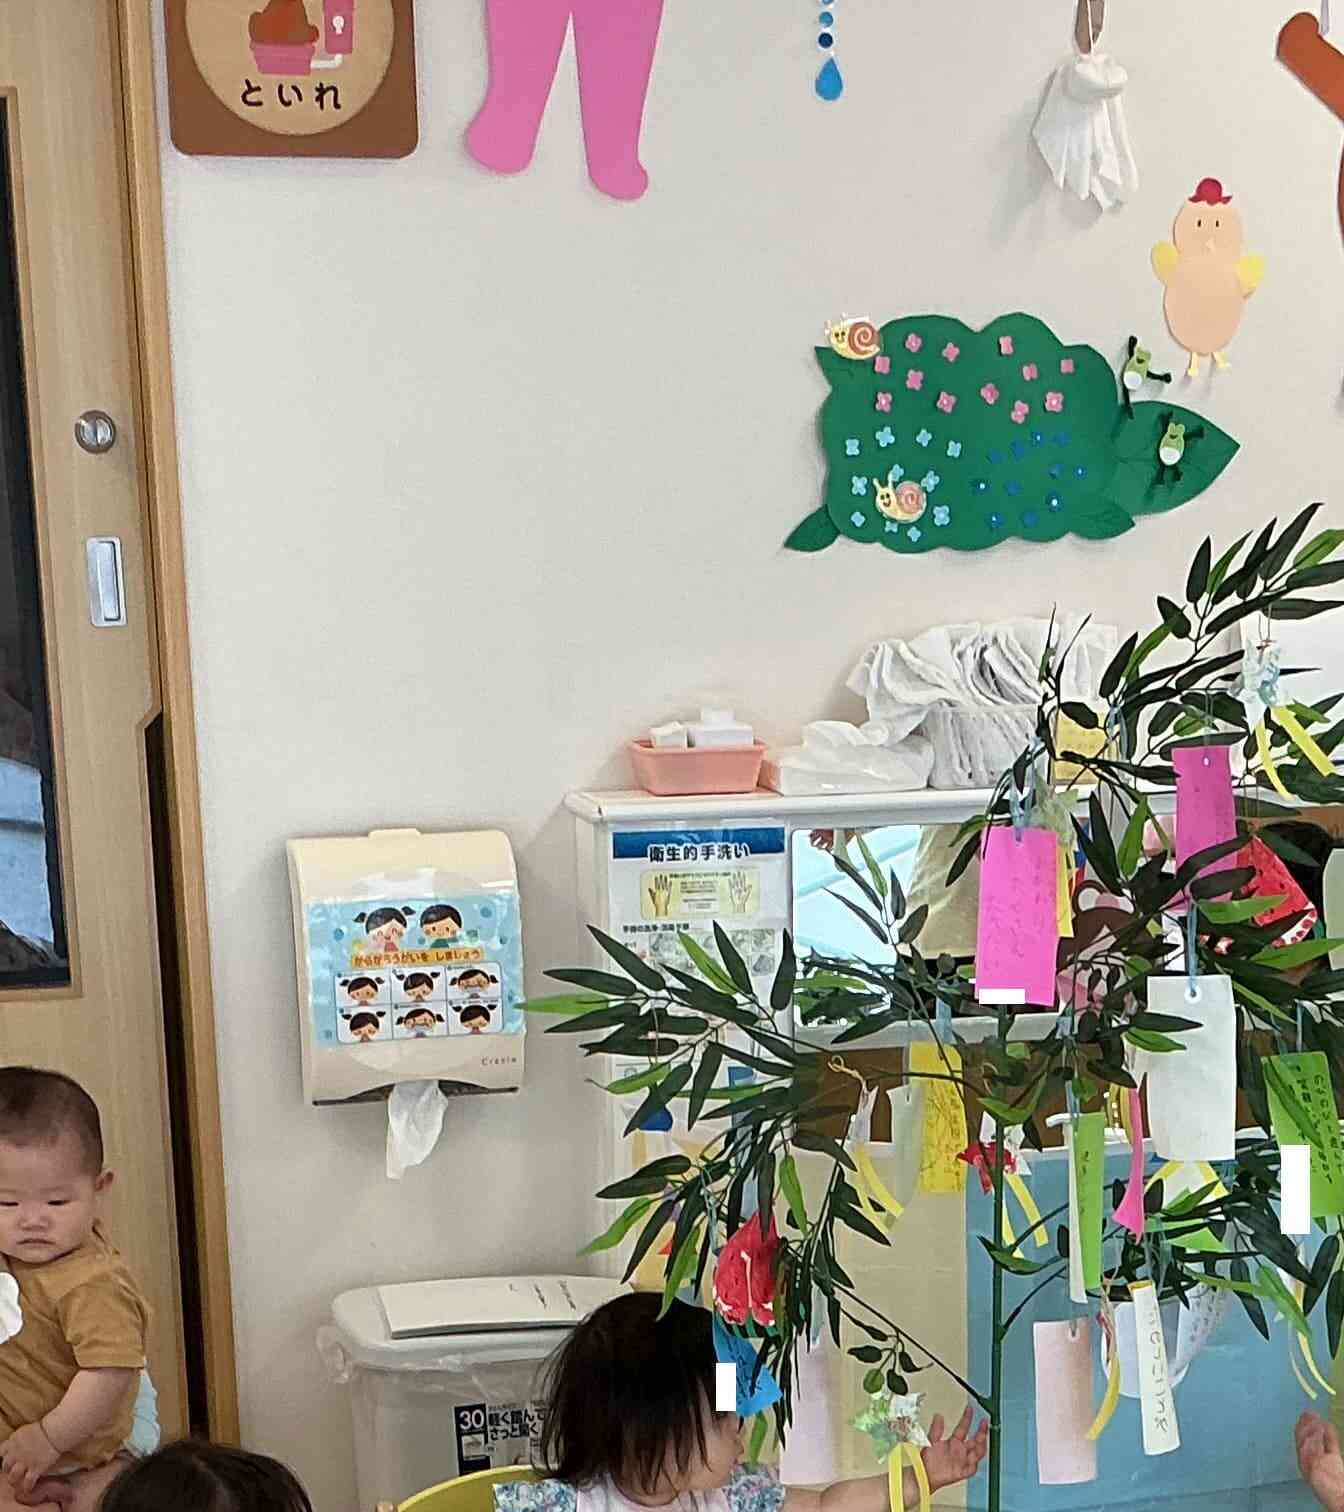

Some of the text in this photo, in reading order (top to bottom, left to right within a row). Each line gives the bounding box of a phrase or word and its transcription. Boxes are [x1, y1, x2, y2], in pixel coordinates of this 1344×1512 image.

[240, 79, 343, 112] といれ
[648, 844, 752, 863] 衛生的手洗い
[459, 1410, 485, 1430] 30
